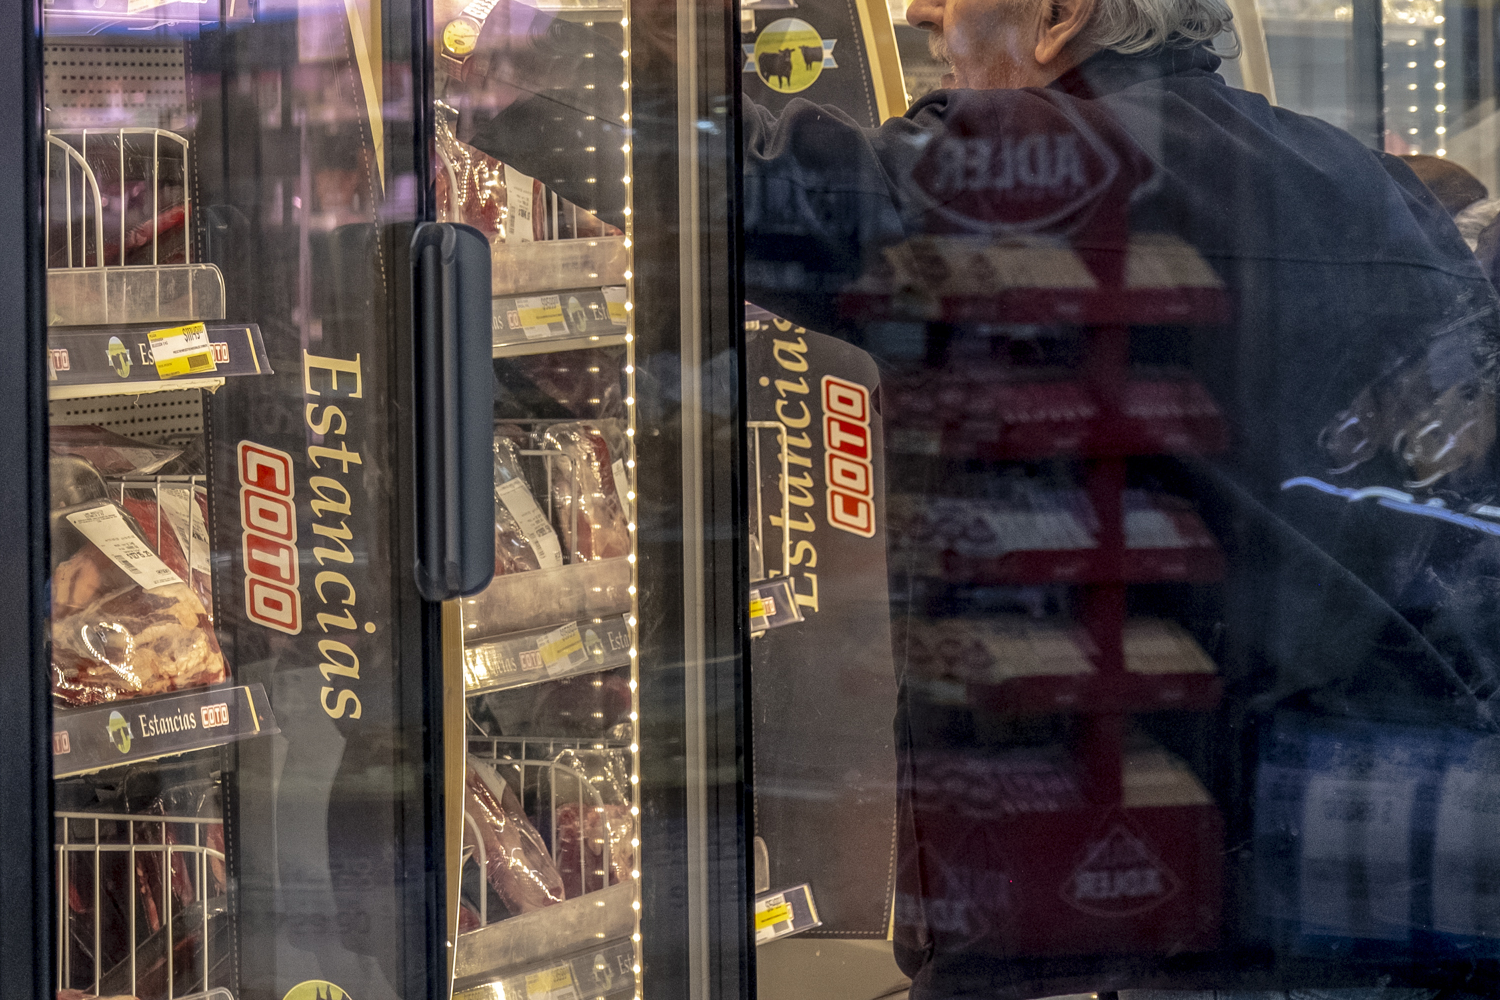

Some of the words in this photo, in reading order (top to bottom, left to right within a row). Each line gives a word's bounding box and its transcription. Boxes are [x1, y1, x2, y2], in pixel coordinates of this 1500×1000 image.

[237, 439, 303, 636] COTO
[303, 348, 377, 721] Estancias
[821, 375, 876, 539] COTO
[138, 708, 197, 738] Estancias
[201, 703, 229, 728] COTO
